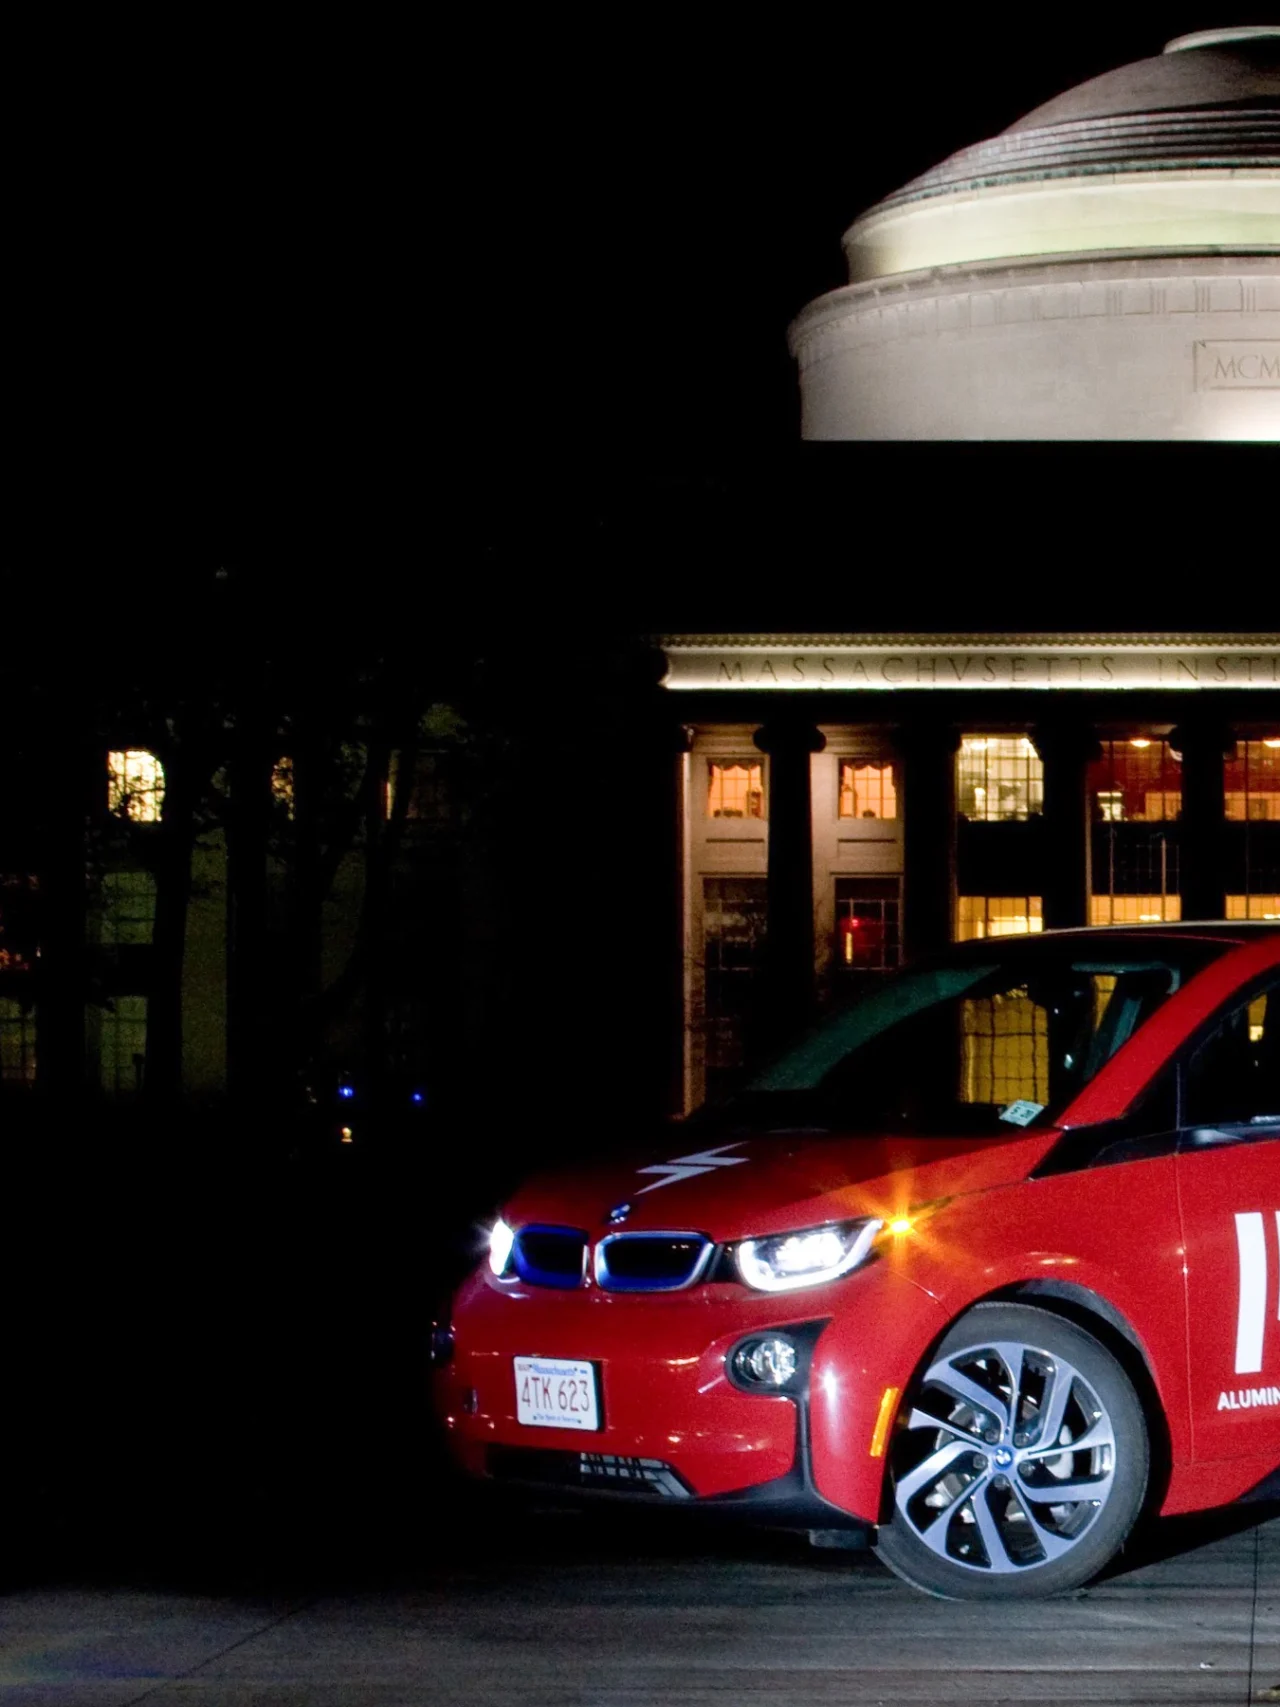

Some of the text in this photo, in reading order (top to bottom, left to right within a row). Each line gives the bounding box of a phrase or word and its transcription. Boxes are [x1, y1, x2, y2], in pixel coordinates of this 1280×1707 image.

[715, 655, 1115, 683] MASSACHVSETTS
[521, 1376, 590, 1412] 4TK 623
